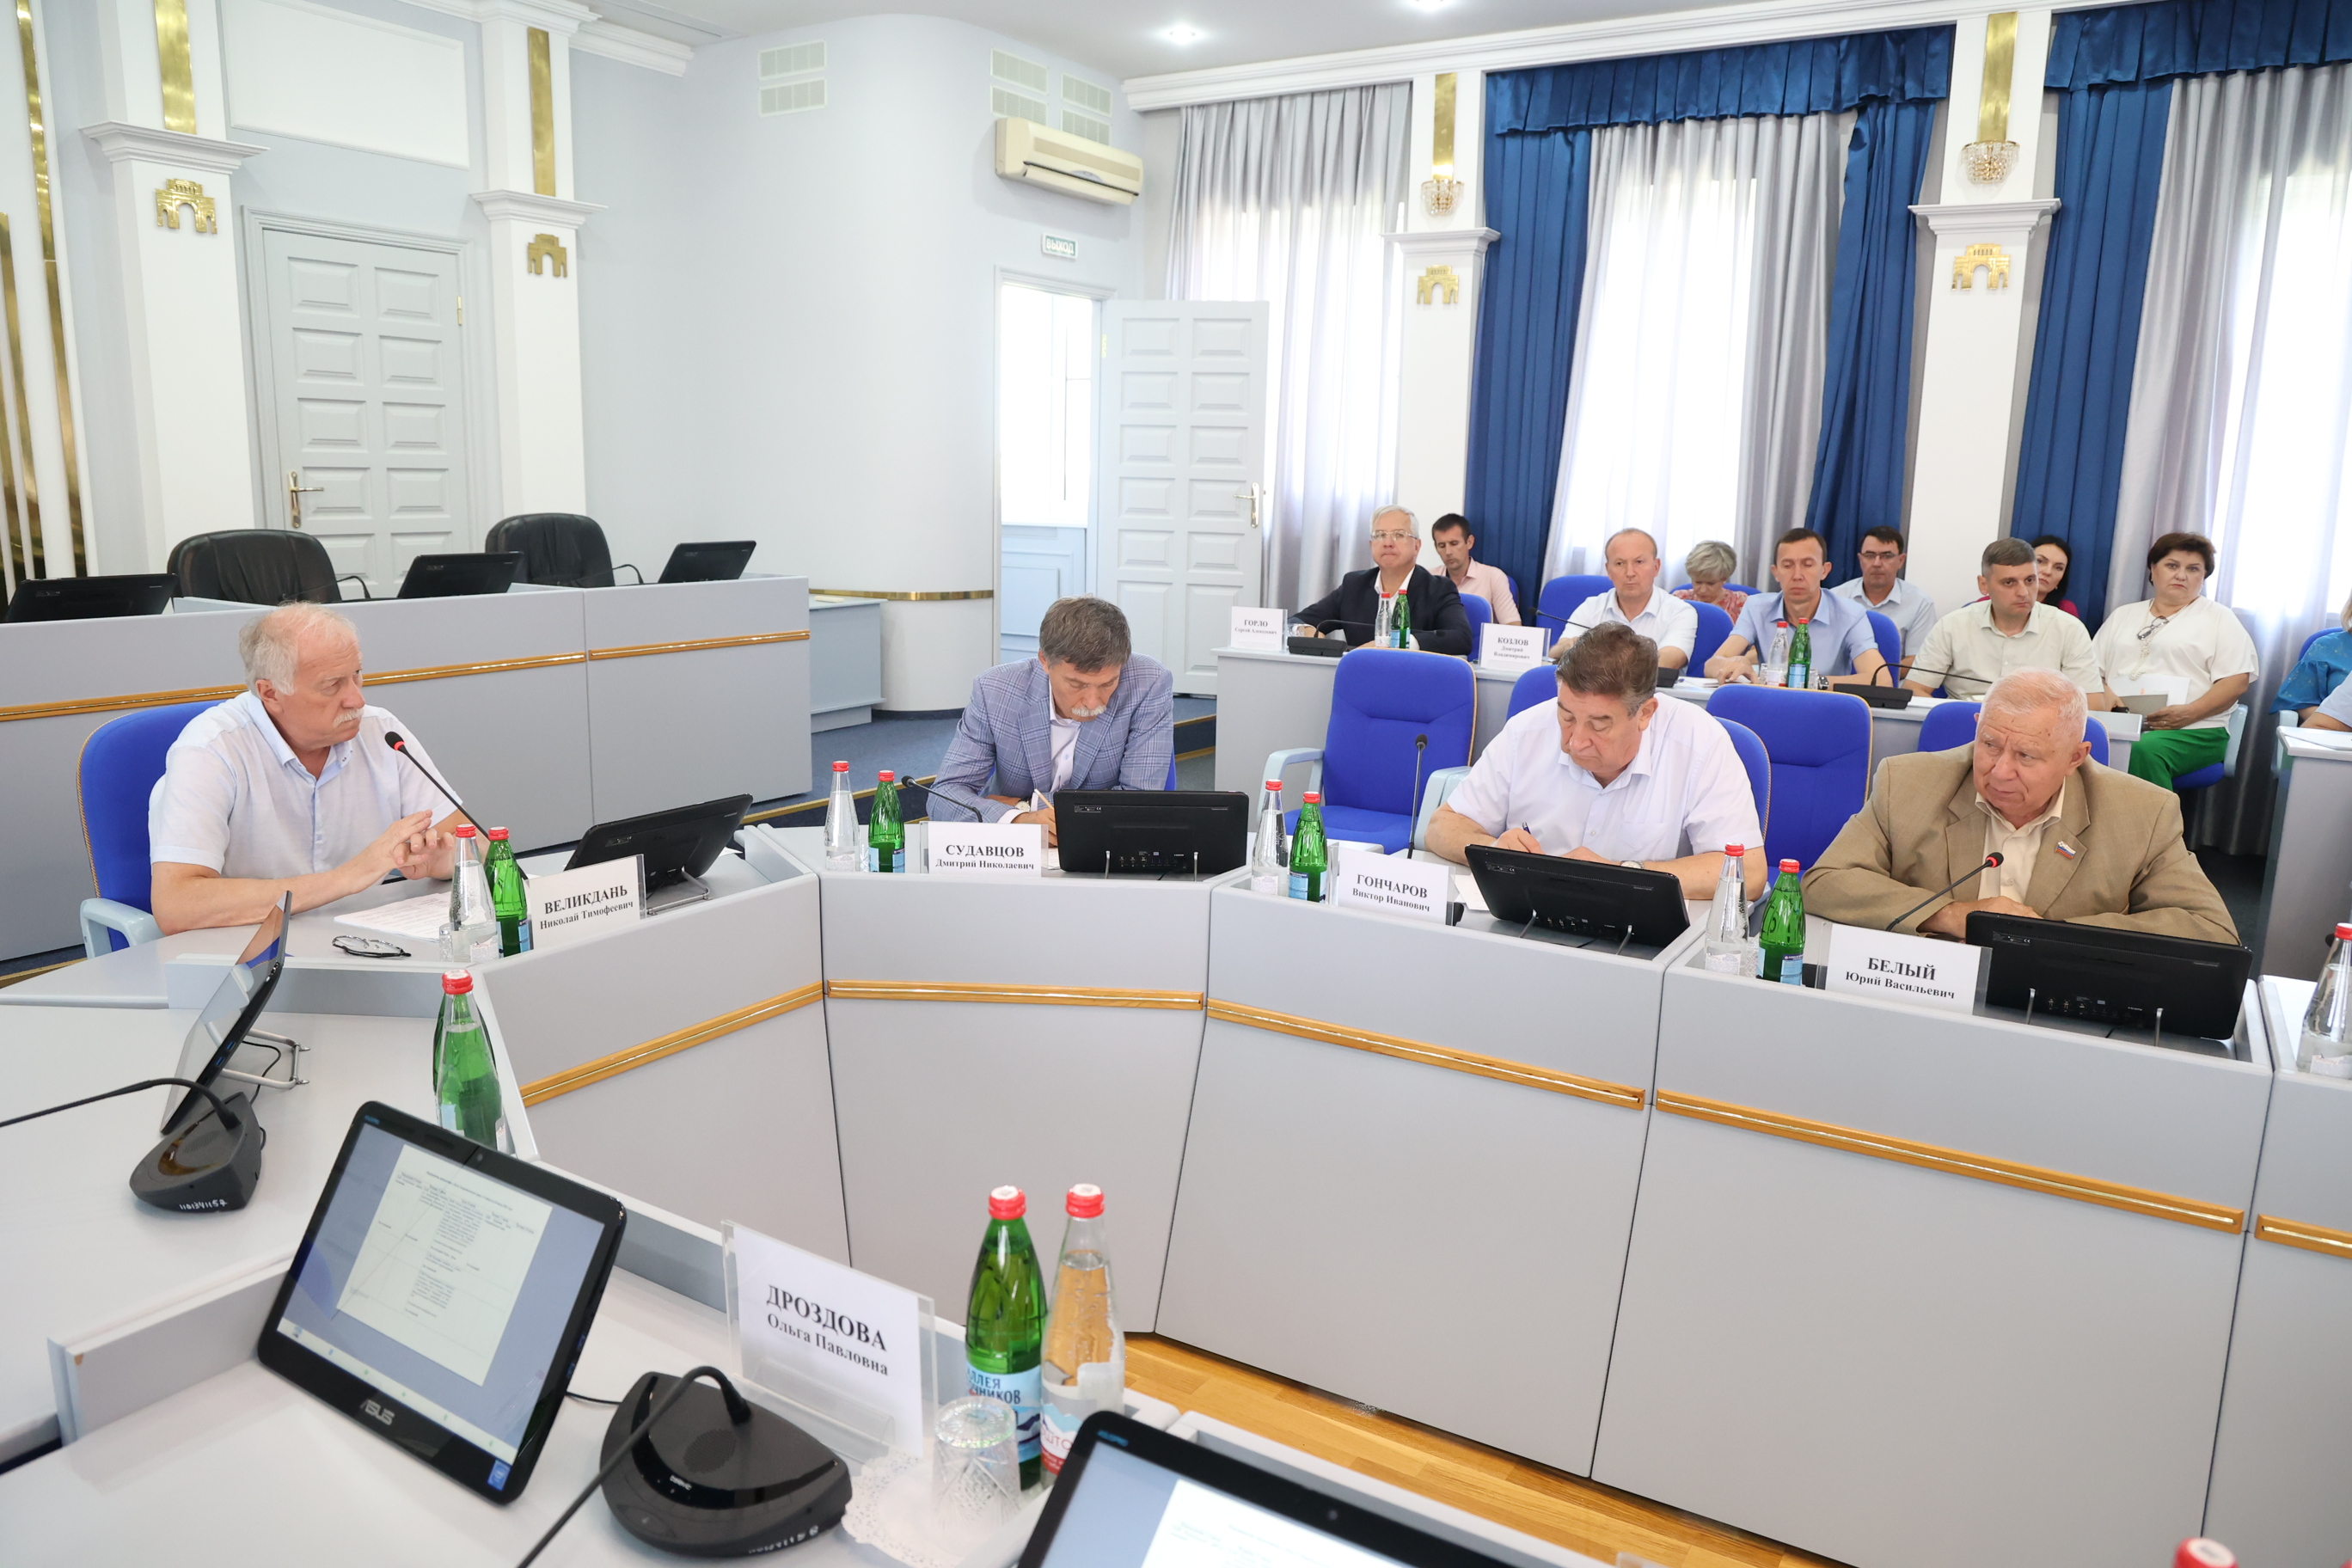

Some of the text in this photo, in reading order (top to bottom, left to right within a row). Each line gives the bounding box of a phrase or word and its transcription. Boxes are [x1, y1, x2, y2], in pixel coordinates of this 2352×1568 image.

[1046, 237, 1075, 254] ВЫХОД
[1498, 637, 1529, 646] КОЗЛОВ
[946, 844, 1025, 859] СУДАВЦОВ
[935, 859, 1034, 870] Дмитрий Николаевич
[1357, 873, 1428, 898] ГОНЧАРОВ
[544, 885, 628, 915] ВЕЛИКДАНЬ
[1352, 887, 1430, 912] Виктор Иванович
[540, 901, 634, 930] Николай Тимофеевич
[1867, 957, 1936, 981] БЕЛЫЙ
[1846, 971, 1955, 999] Юрий Васильевич
[766, 1284, 887, 1352] ДРОЗДОВА
[767, 1313, 889, 1376] Ольга Павловна
[360, 1400, 395, 1425] ASUS
